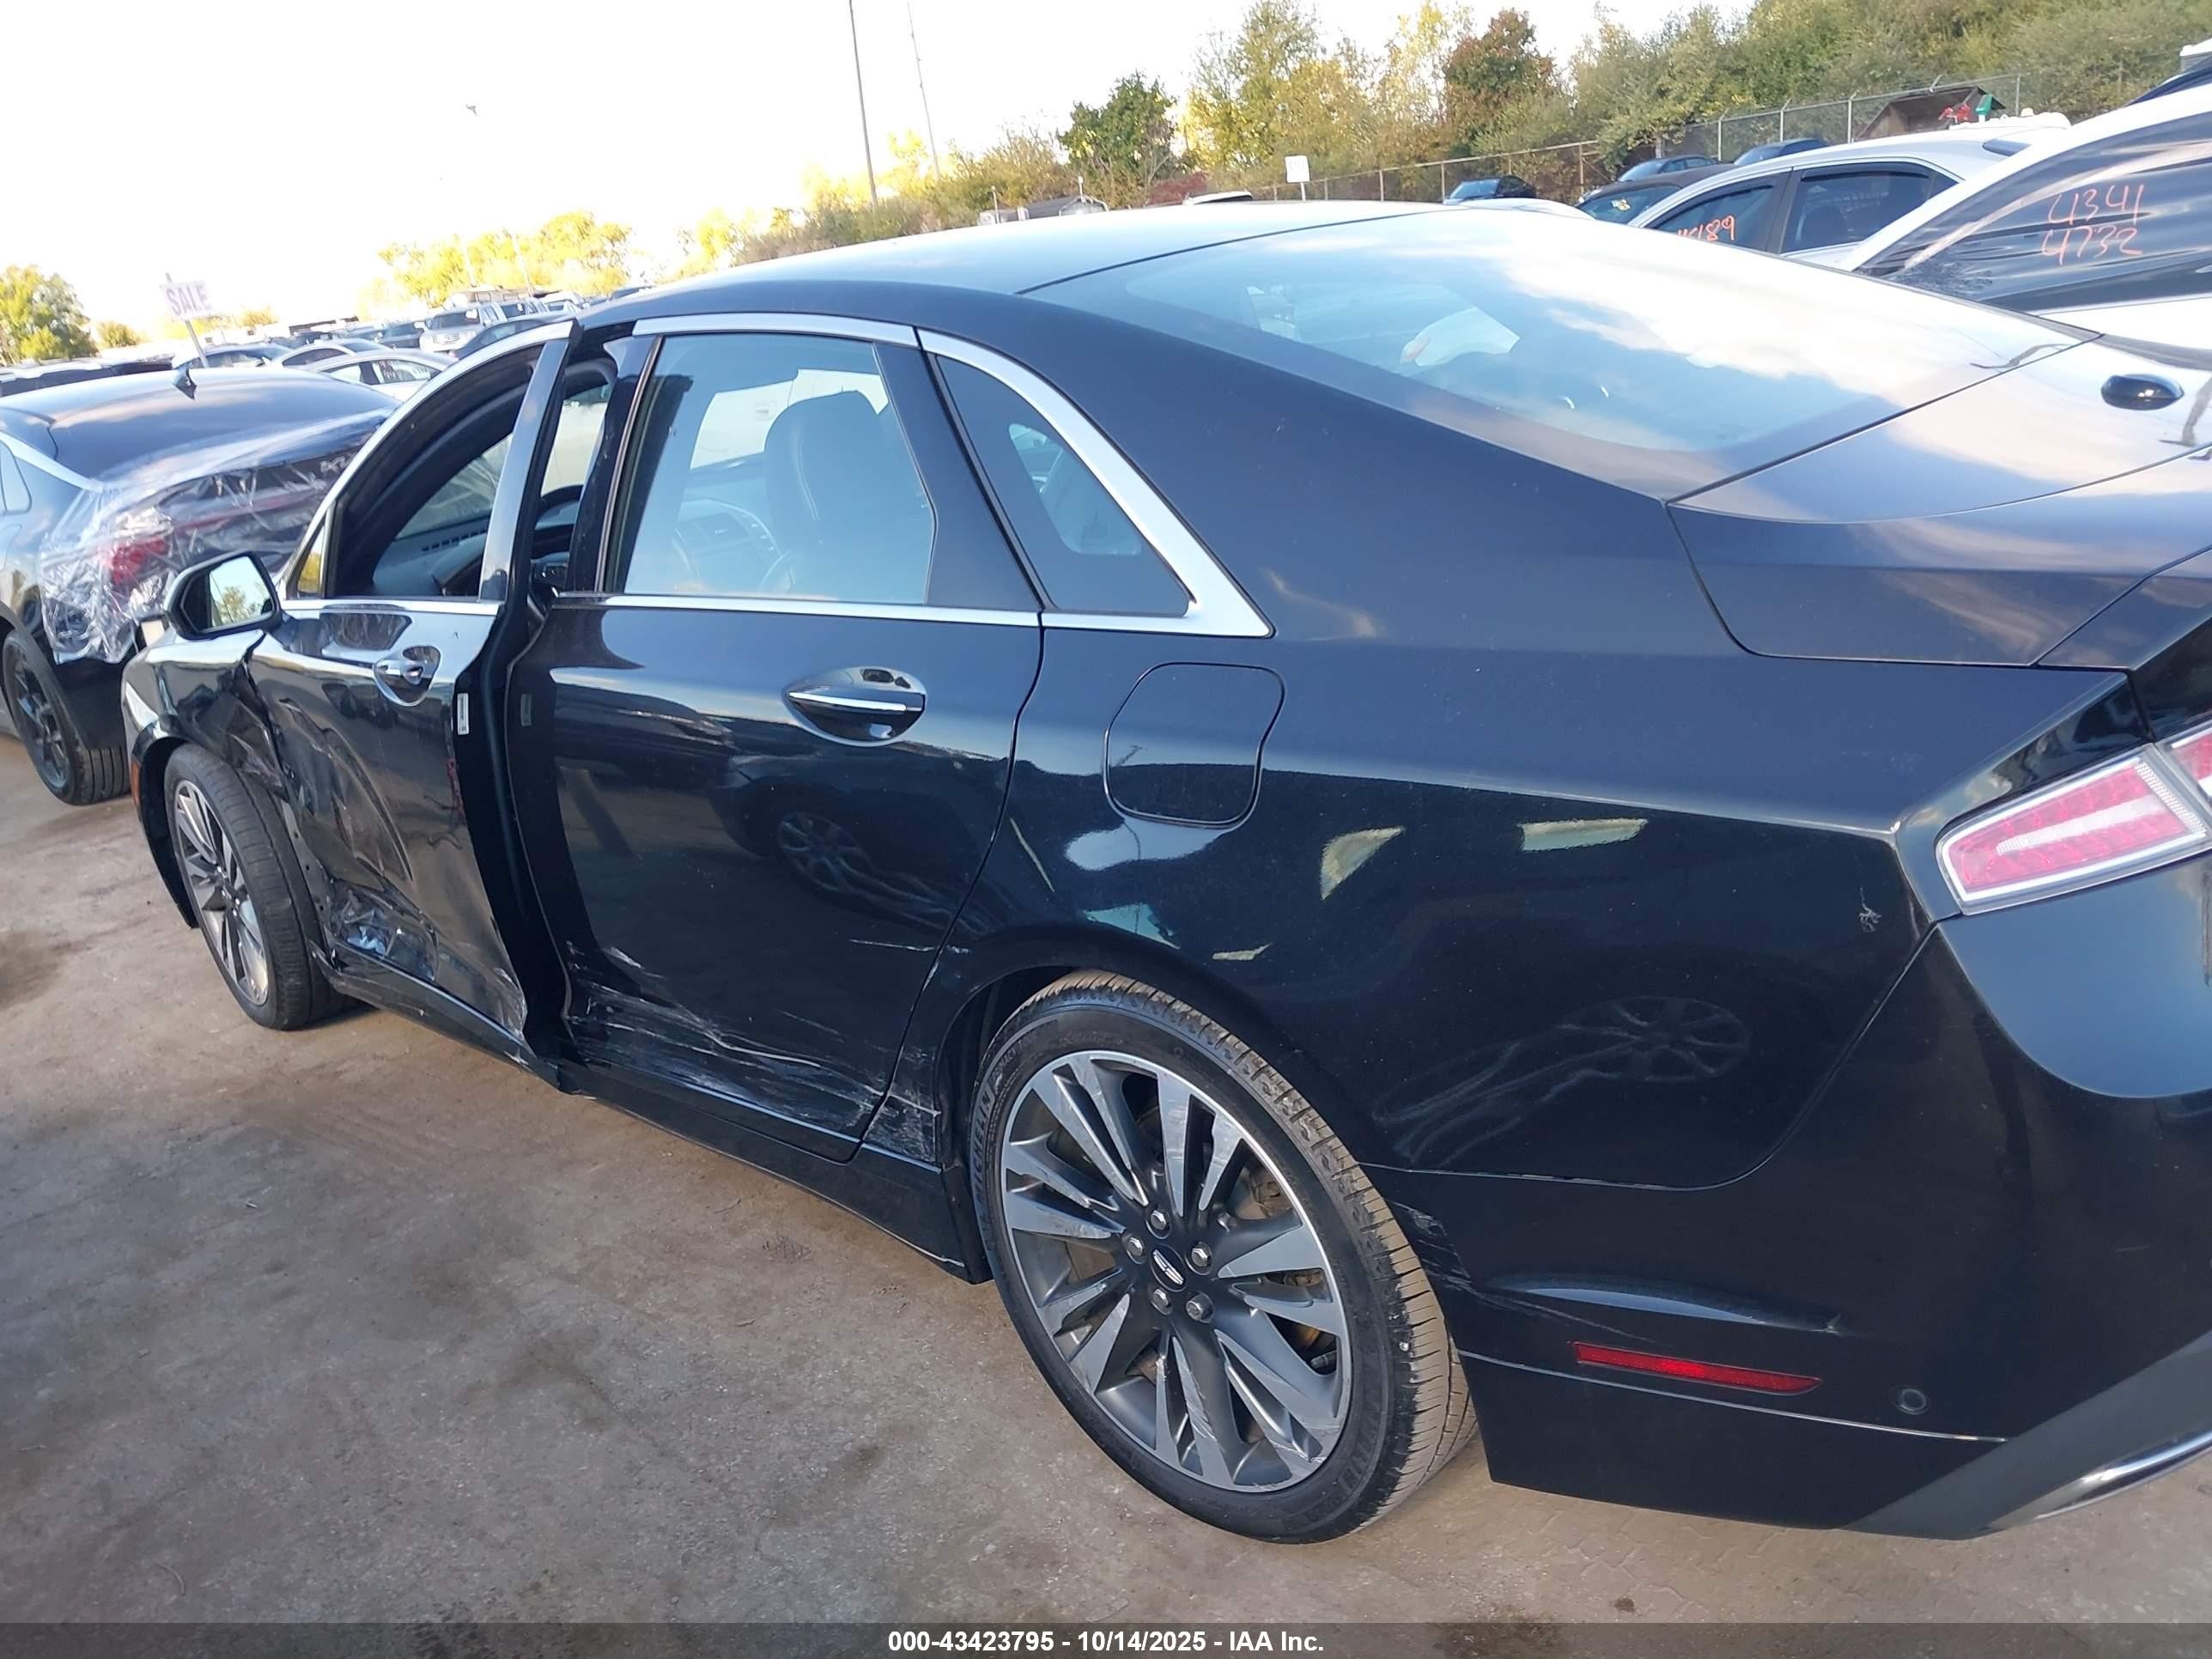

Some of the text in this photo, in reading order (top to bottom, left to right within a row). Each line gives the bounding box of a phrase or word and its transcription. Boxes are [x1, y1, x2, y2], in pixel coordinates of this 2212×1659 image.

[2048, 184, 2144, 225] 4341
[2042, 224, 2143, 265] 4732
[166, 285, 213, 316] SALE
[974, 1091, 991, 1204] MICHELIN
